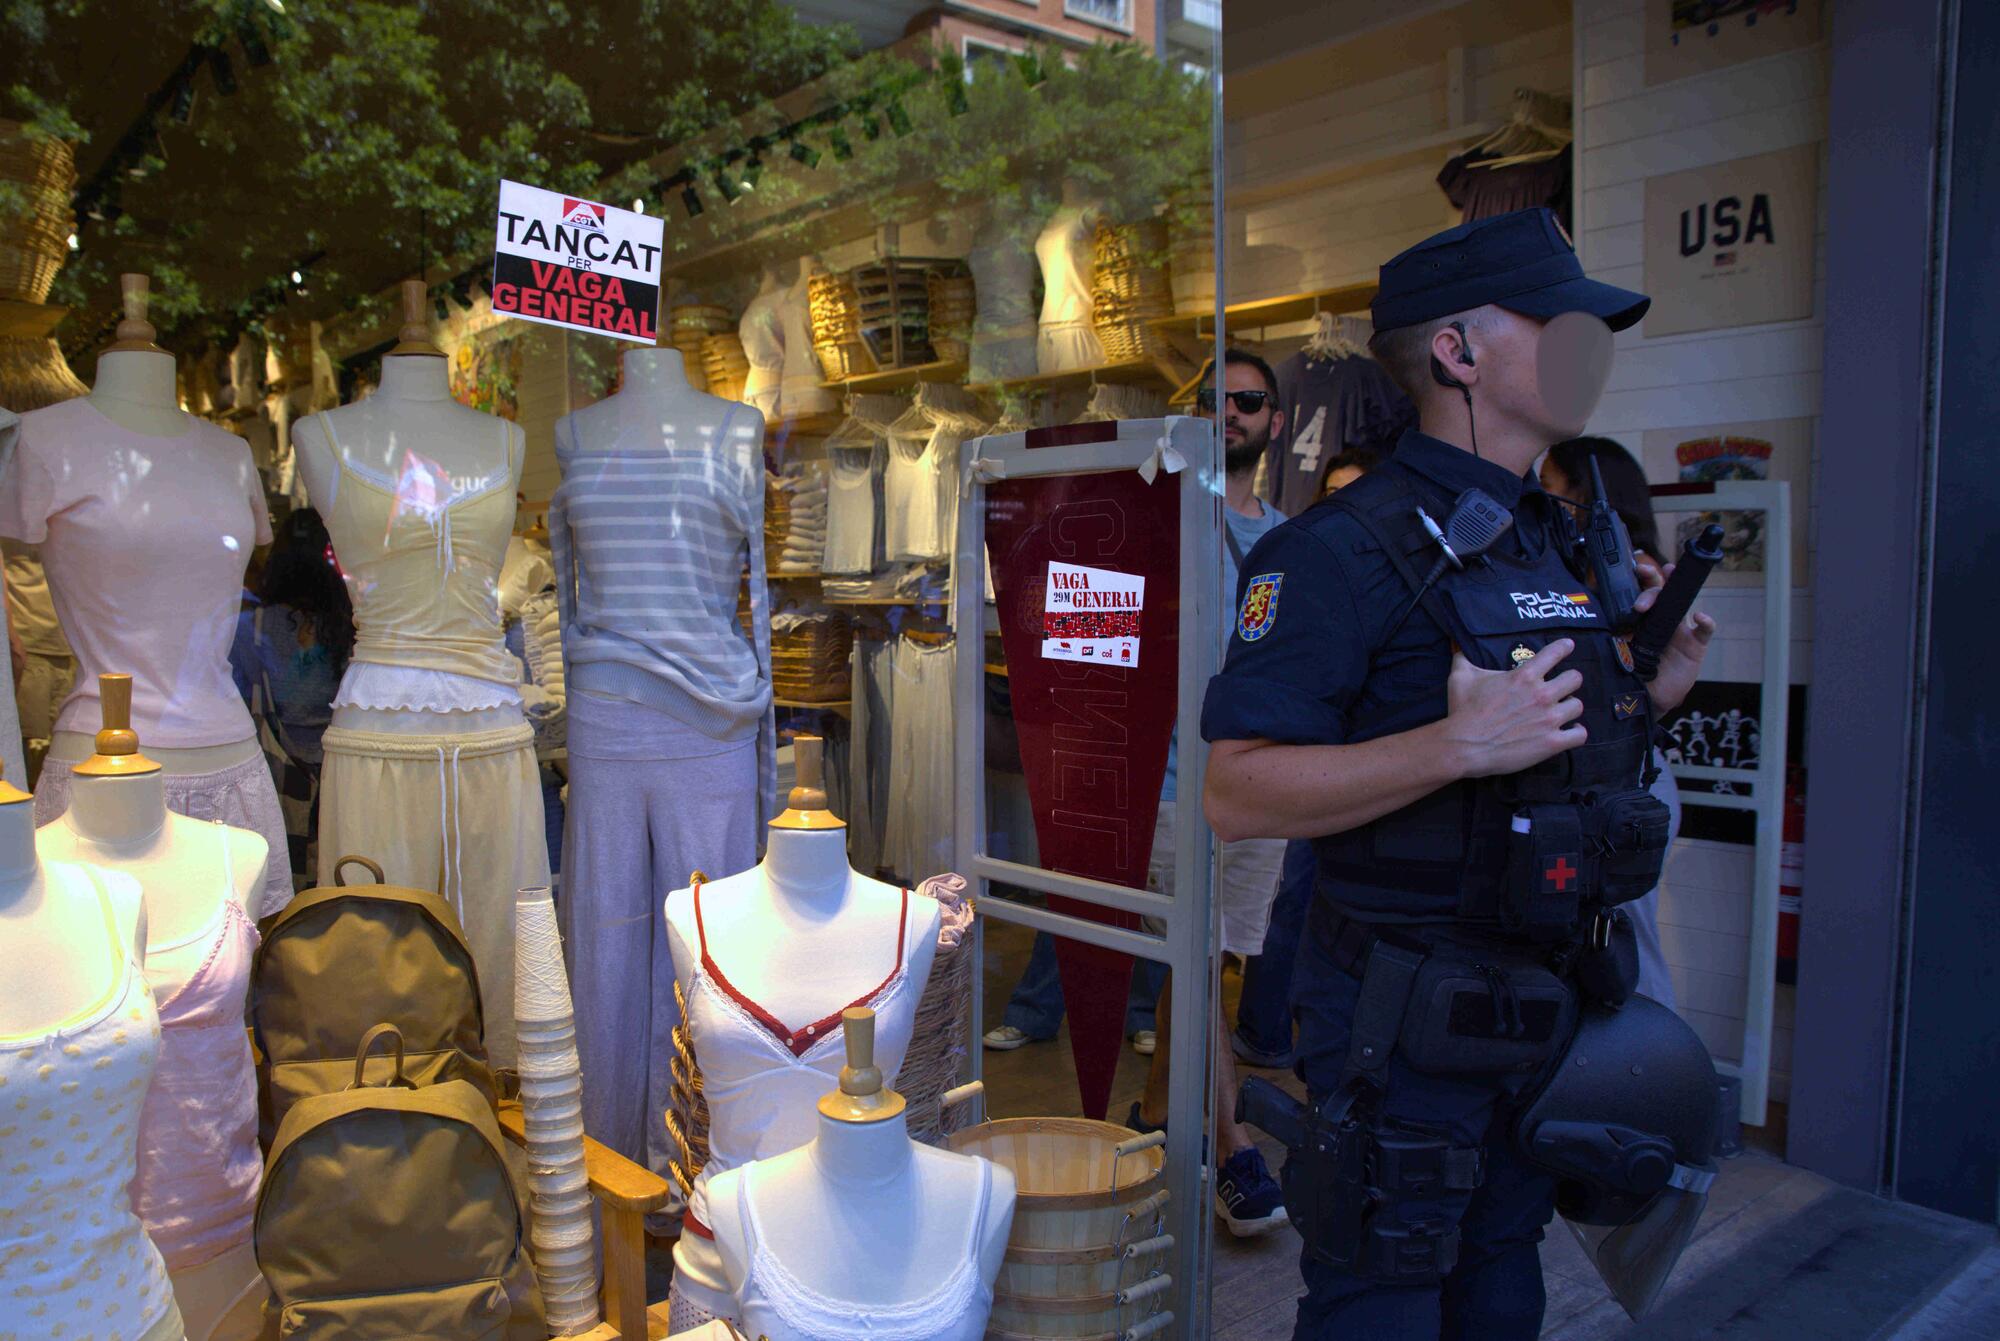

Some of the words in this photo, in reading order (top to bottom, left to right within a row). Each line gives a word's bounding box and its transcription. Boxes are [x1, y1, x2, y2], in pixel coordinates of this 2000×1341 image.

[574, 214, 592, 226] CGT
[1680, 193, 1775, 258] USA
[500, 211, 661, 273] TANCAT
[568, 256, 592, 270] PER
[531, 260, 626, 306] VAGA
[493, 282, 657, 340] GENERAL
[1052, 572, 1089, 589] VAGA
[1053, 592, 1071, 603] 29M
[1072, 591, 1140, 608] GENERAL
[1517, 604, 1598, 619] NACIONAL
